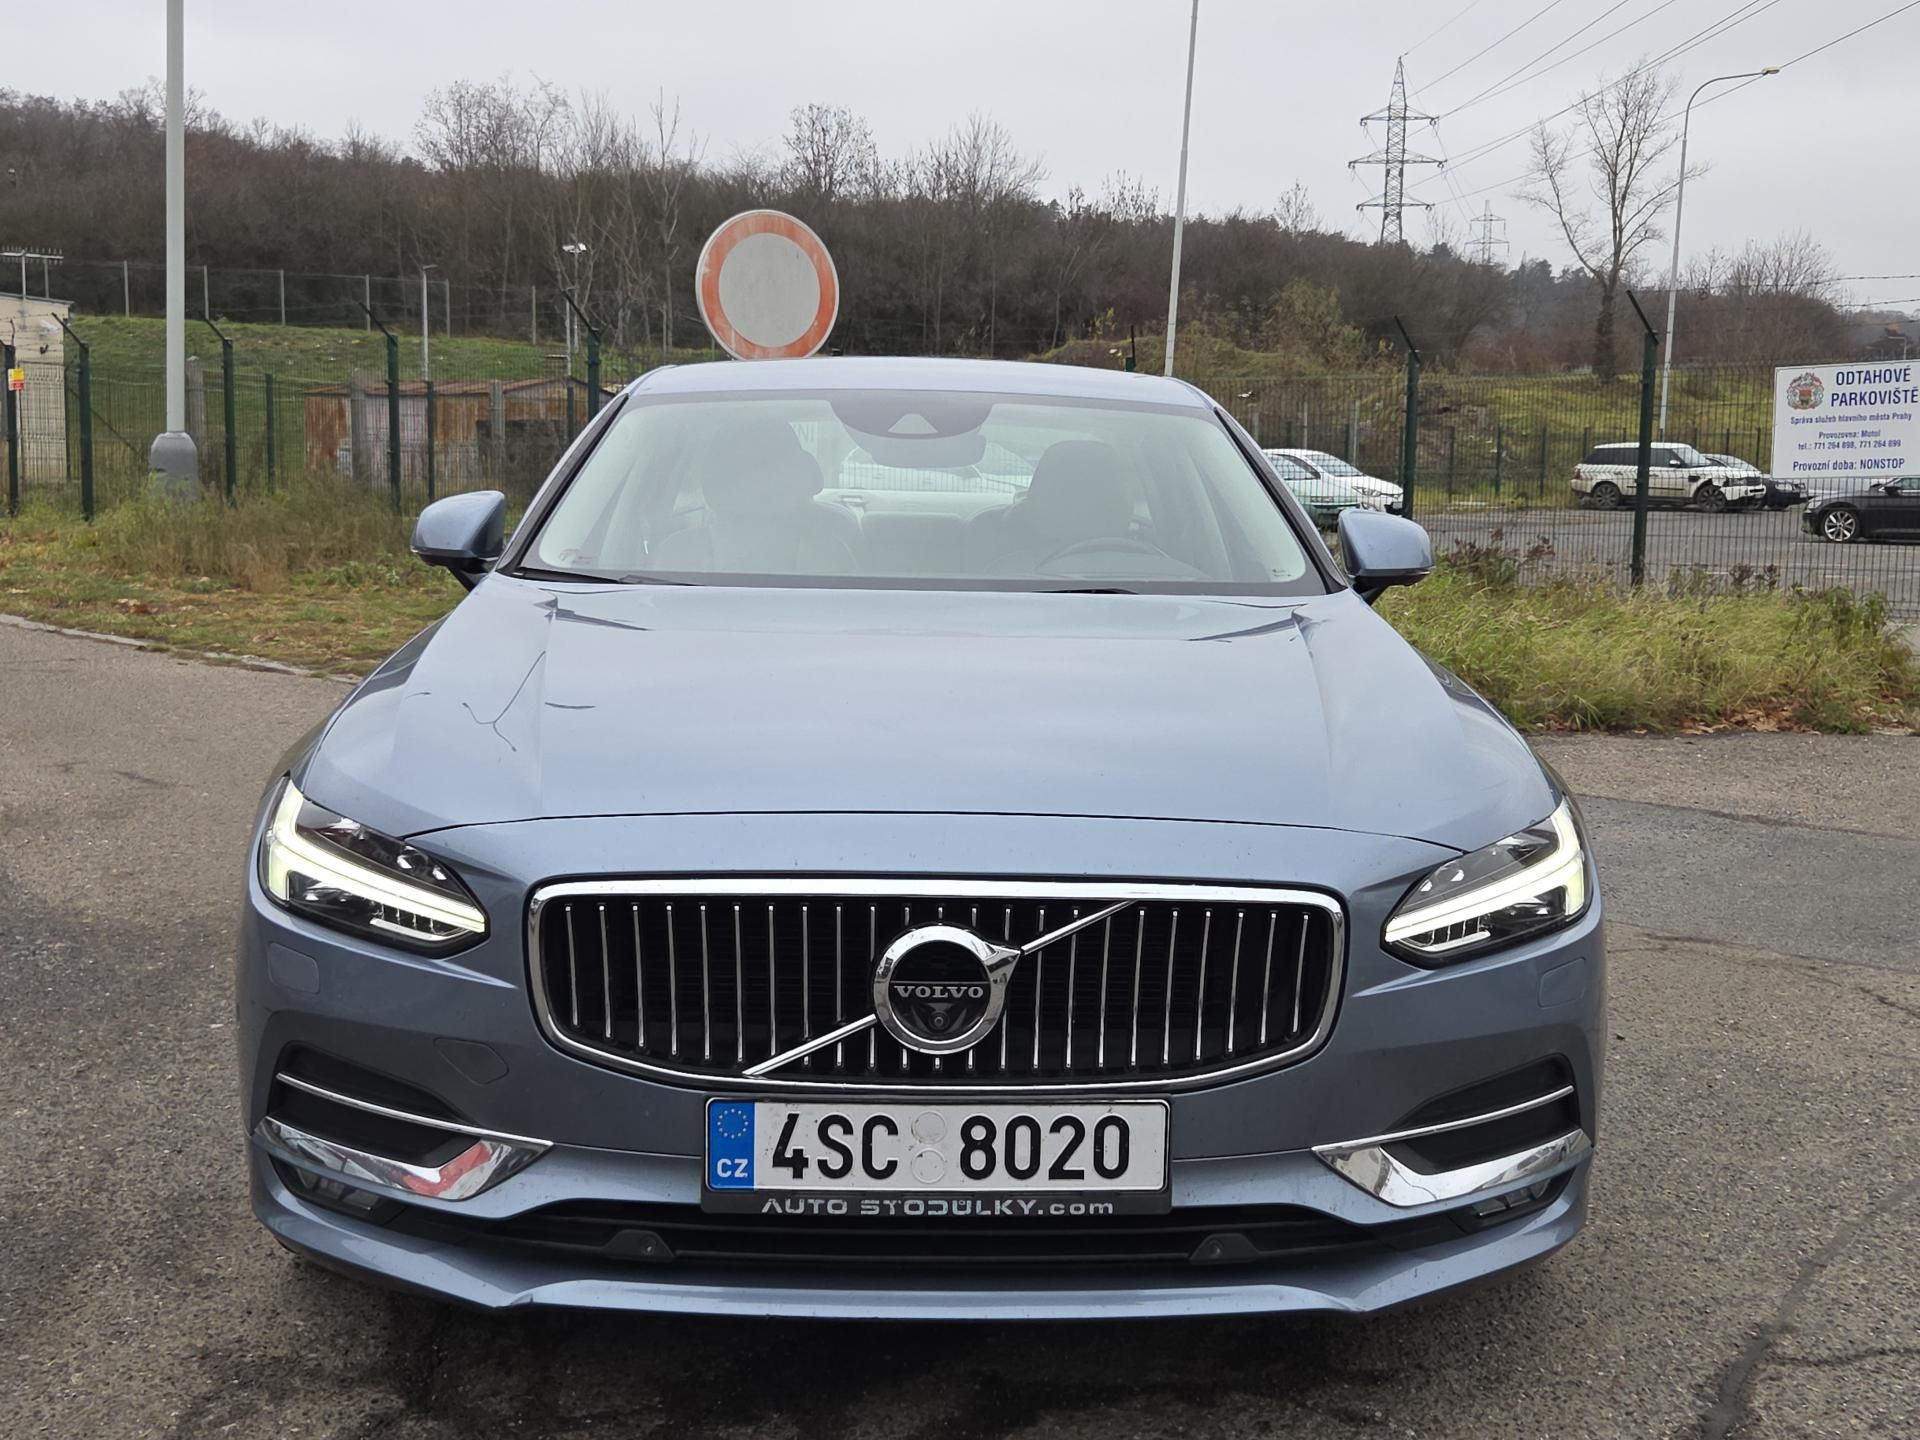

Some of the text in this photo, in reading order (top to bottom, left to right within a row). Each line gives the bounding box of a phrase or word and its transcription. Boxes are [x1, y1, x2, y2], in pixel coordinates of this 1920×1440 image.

[1836, 366, 1911, 385] ODTAHOVÉ
[1831, 386, 1919, 406] PARKOVIŠTĚ
[1791, 416, 1813, 424] Správa
[1816, 415, 1836, 423] služeb
[1839, 414, 1867, 422] hlavního
[1892, 412, 1912, 421] Prahy
[1793, 458, 1905, 471] Provozní doba: NONSTOP
[894, 985, 984, 999] VOLVO
[772, 1113, 1130, 1180] 4SC 8020
[716, 1159, 748, 1178] CZ
[761, 1199, 848, 1214] AUTO
